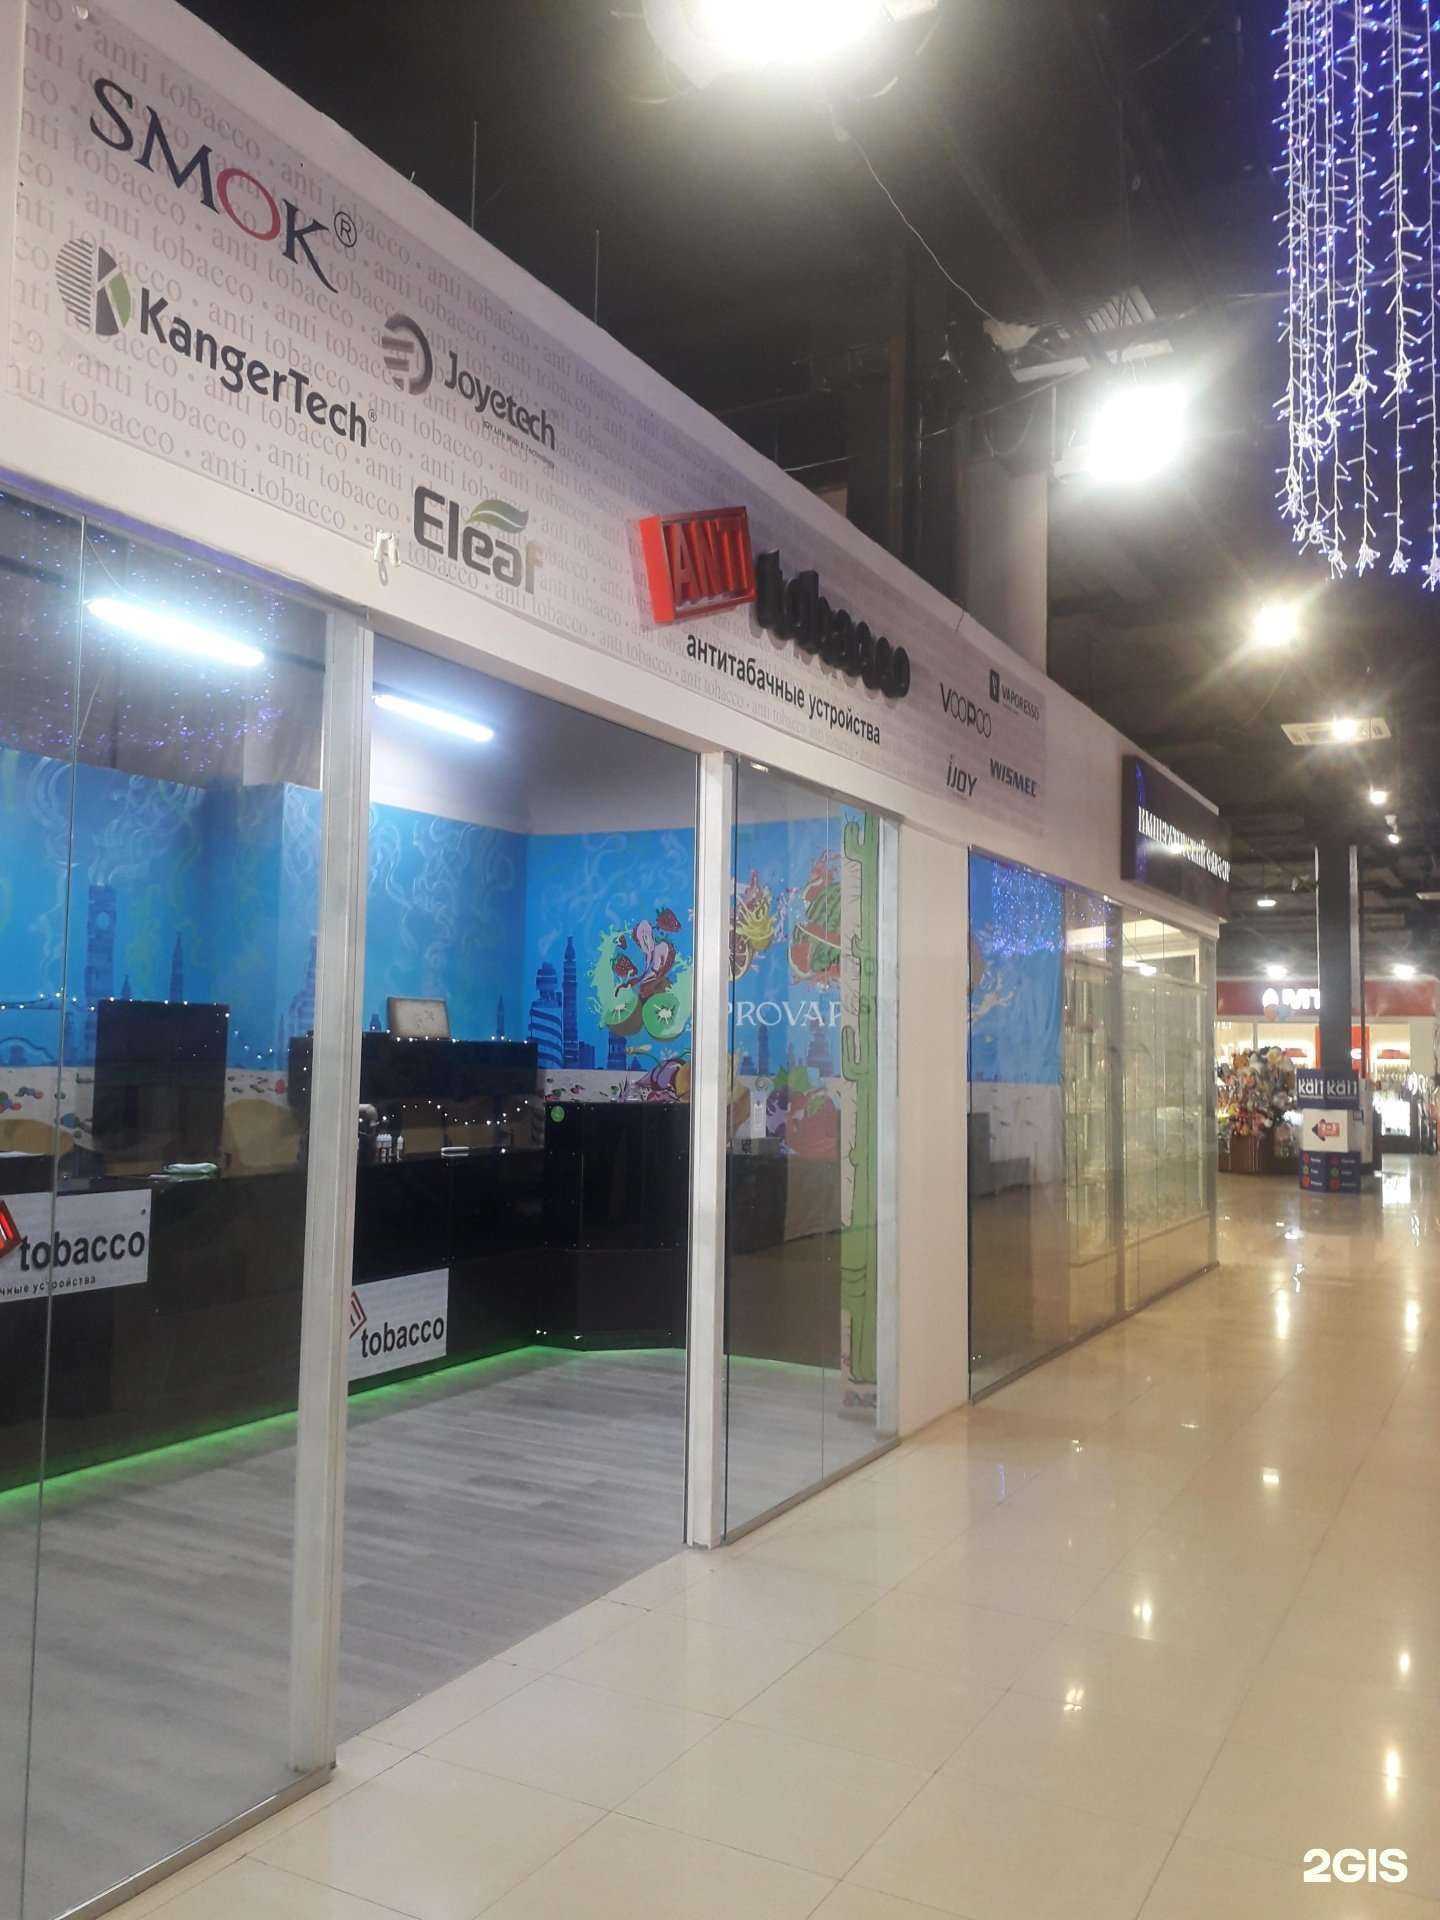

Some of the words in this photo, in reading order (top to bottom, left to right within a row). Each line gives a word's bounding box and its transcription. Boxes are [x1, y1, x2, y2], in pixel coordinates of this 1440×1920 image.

[159, 73, 259, 160] tobacco
[72, 136, 184, 227] tobacco
[211, 226, 256, 270] anti
[267, 258, 351, 328] tobacco
[85, 190, 139, 240] anti
[152, 226, 252, 305] tobacco
[274, 302, 315, 341] anti
[208, 301, 255, 343] anti
[264, 329, 350, 396] tobacco
[77, 353, 132, 398] anti
[144, 381, 245, 450] tobacco
[267, 444, 310, 480] anti
[320, 465, 398, 520] tobacco
[260, 400, 346, 462] tobacco
[444, 350, 556, 450] Joyetech
[60, 384, 172, 455] tobacco
[200, 450, 246, 487] anti
[256, 471, 343, 529] tobacco
[413, 485, 544, 595] Eleaf
[686, 634, 805, 709] антитабачные
[808, 690, 881, 745] устройства
[940, 682, 993, 738] VOOPOO
[990, 758, 1039, 798] WISMEC
[20, 1231, 146, 1271] tobacco
[361, 1317, 444, 1358] tobacco
